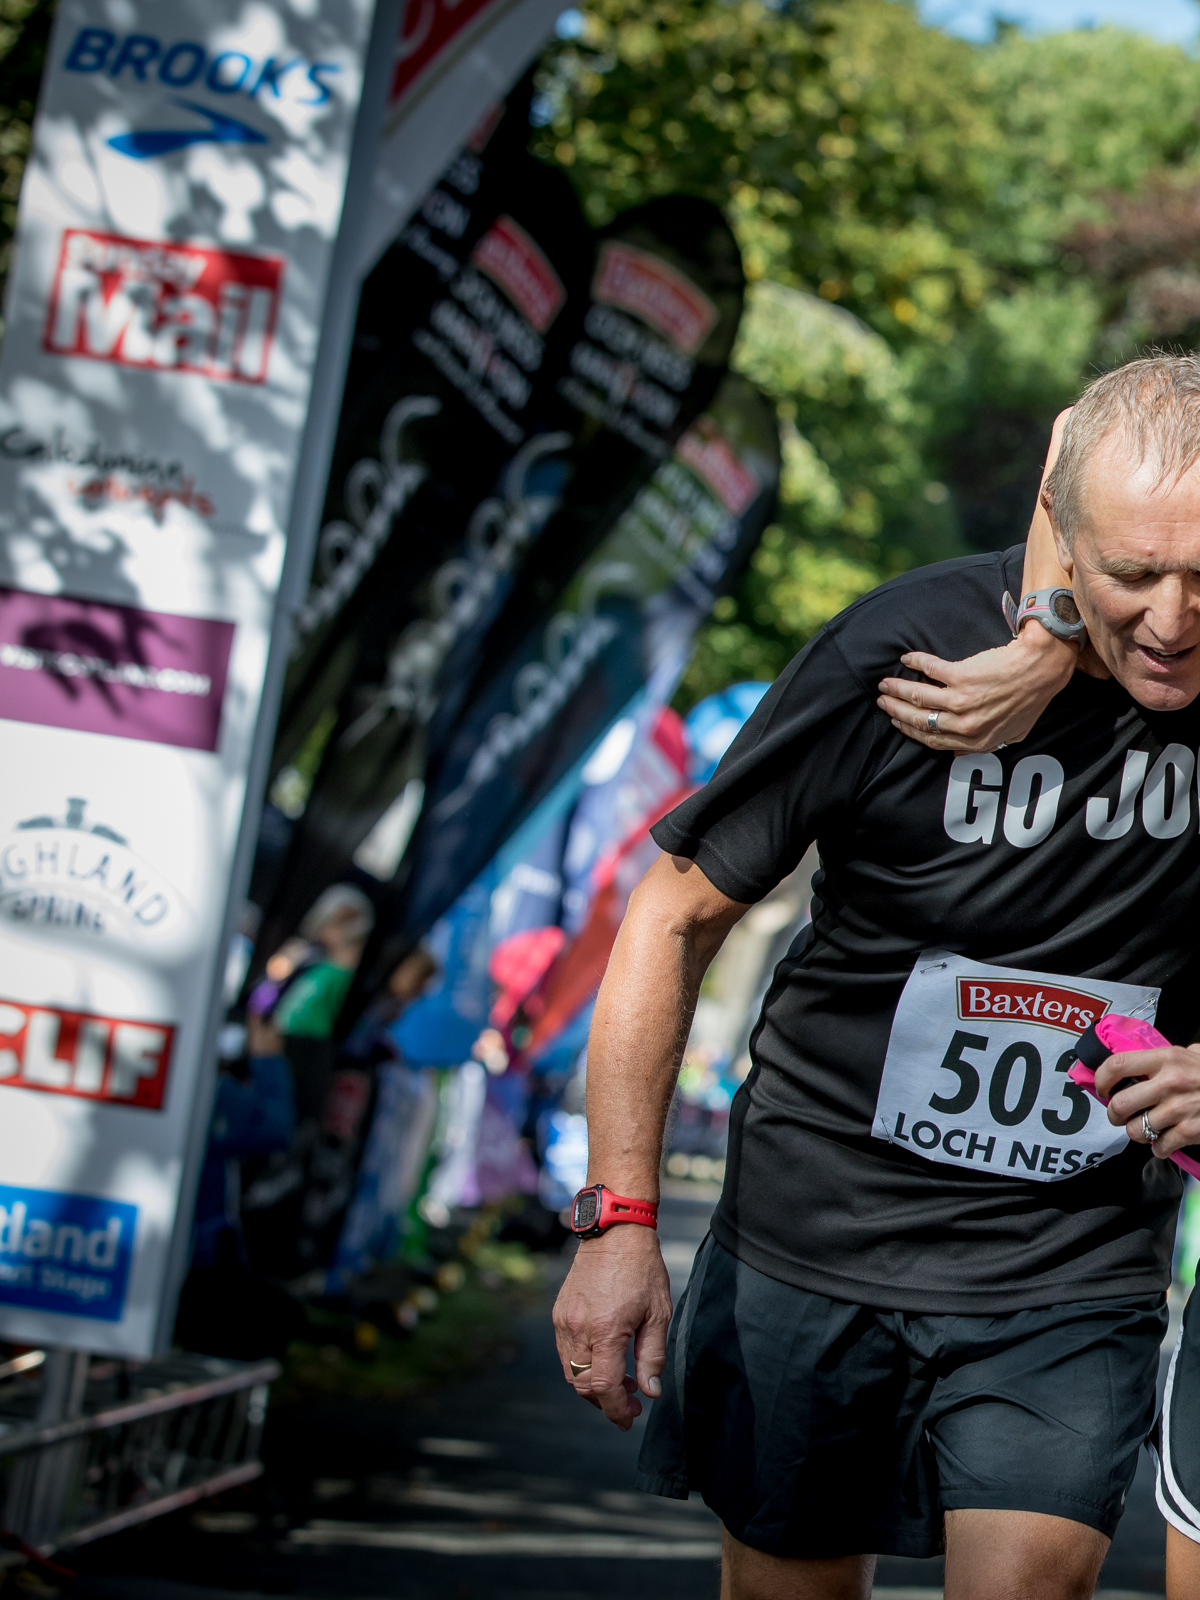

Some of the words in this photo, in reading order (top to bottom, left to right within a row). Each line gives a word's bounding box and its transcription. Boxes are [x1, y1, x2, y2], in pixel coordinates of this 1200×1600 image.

[64, 27, 343, 107] BROOKS
[50, 265, 274, 380] Mail
[943, 752, 1064, 849] GO
[967, 985, 1095, 1030] Baxters
[927, 1029, 1092, 1136] 503
[893, 1111, 997, 1163] LOCH
